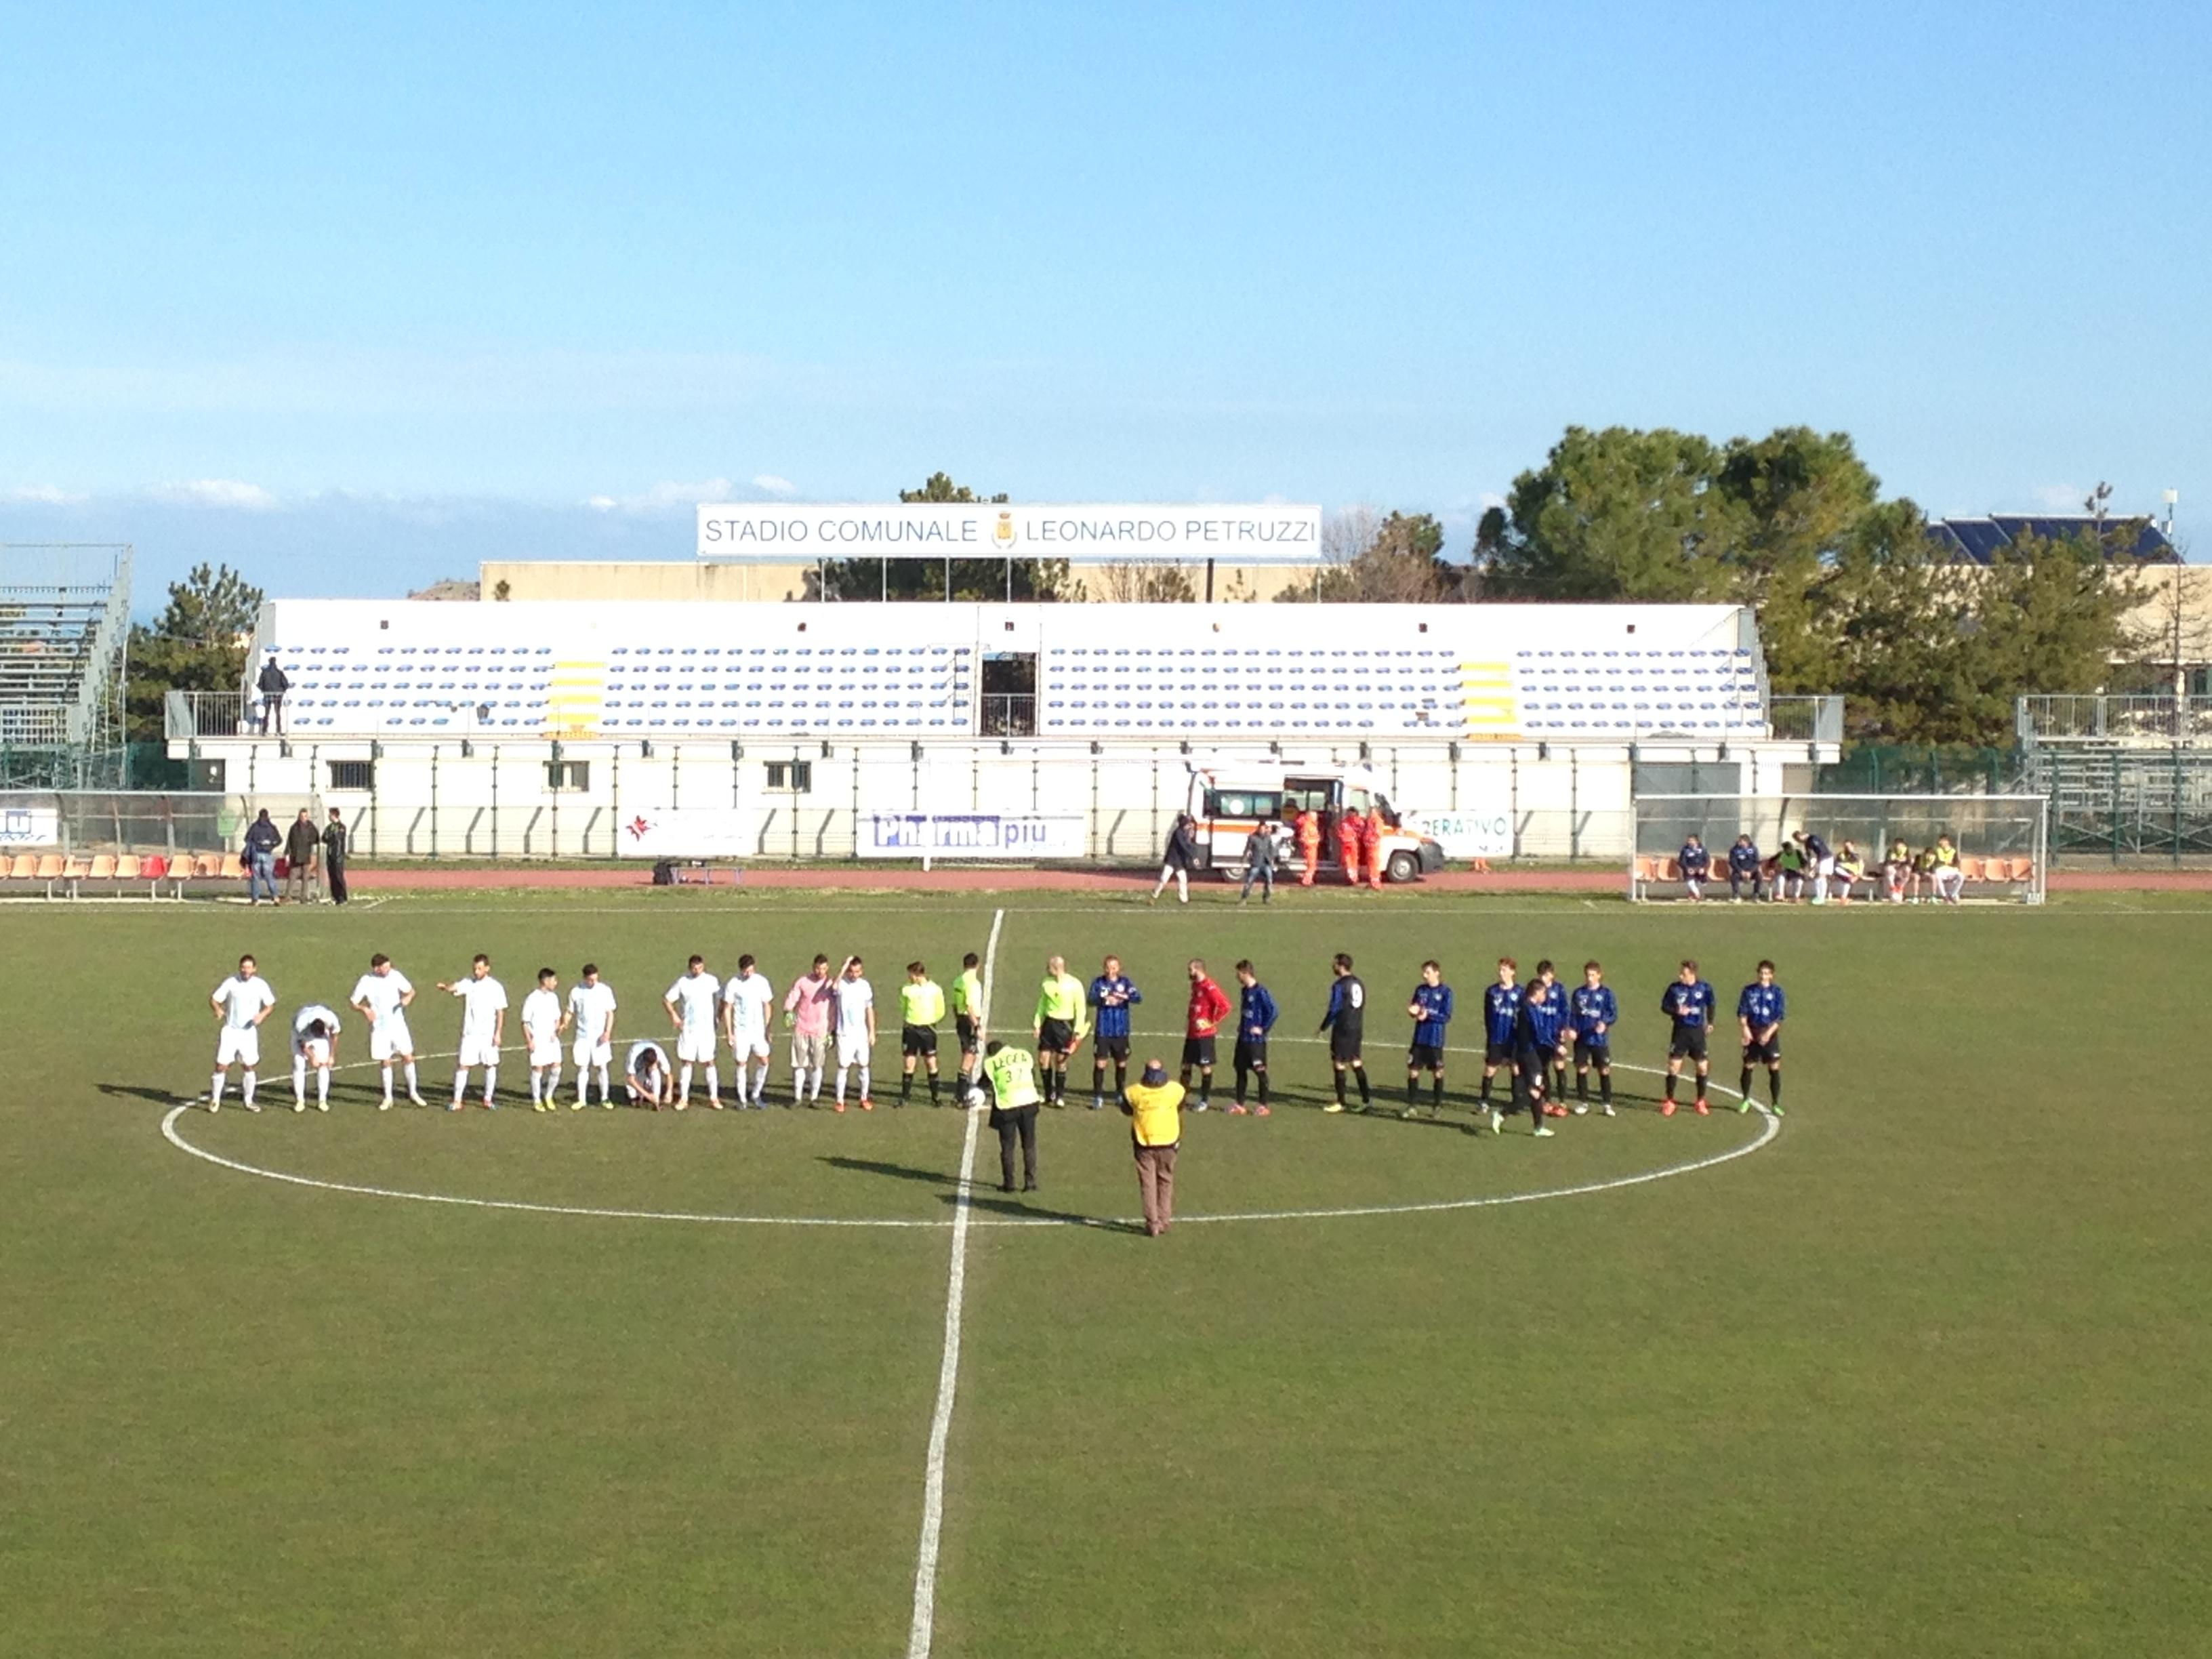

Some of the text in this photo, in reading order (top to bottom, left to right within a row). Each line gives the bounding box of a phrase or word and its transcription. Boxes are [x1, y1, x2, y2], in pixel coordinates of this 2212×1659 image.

[706, 520, 1315, 541] STADIO COMUNALE LEONARDO PETRUZZI
[1351, 983, 1363, 1008] 9
